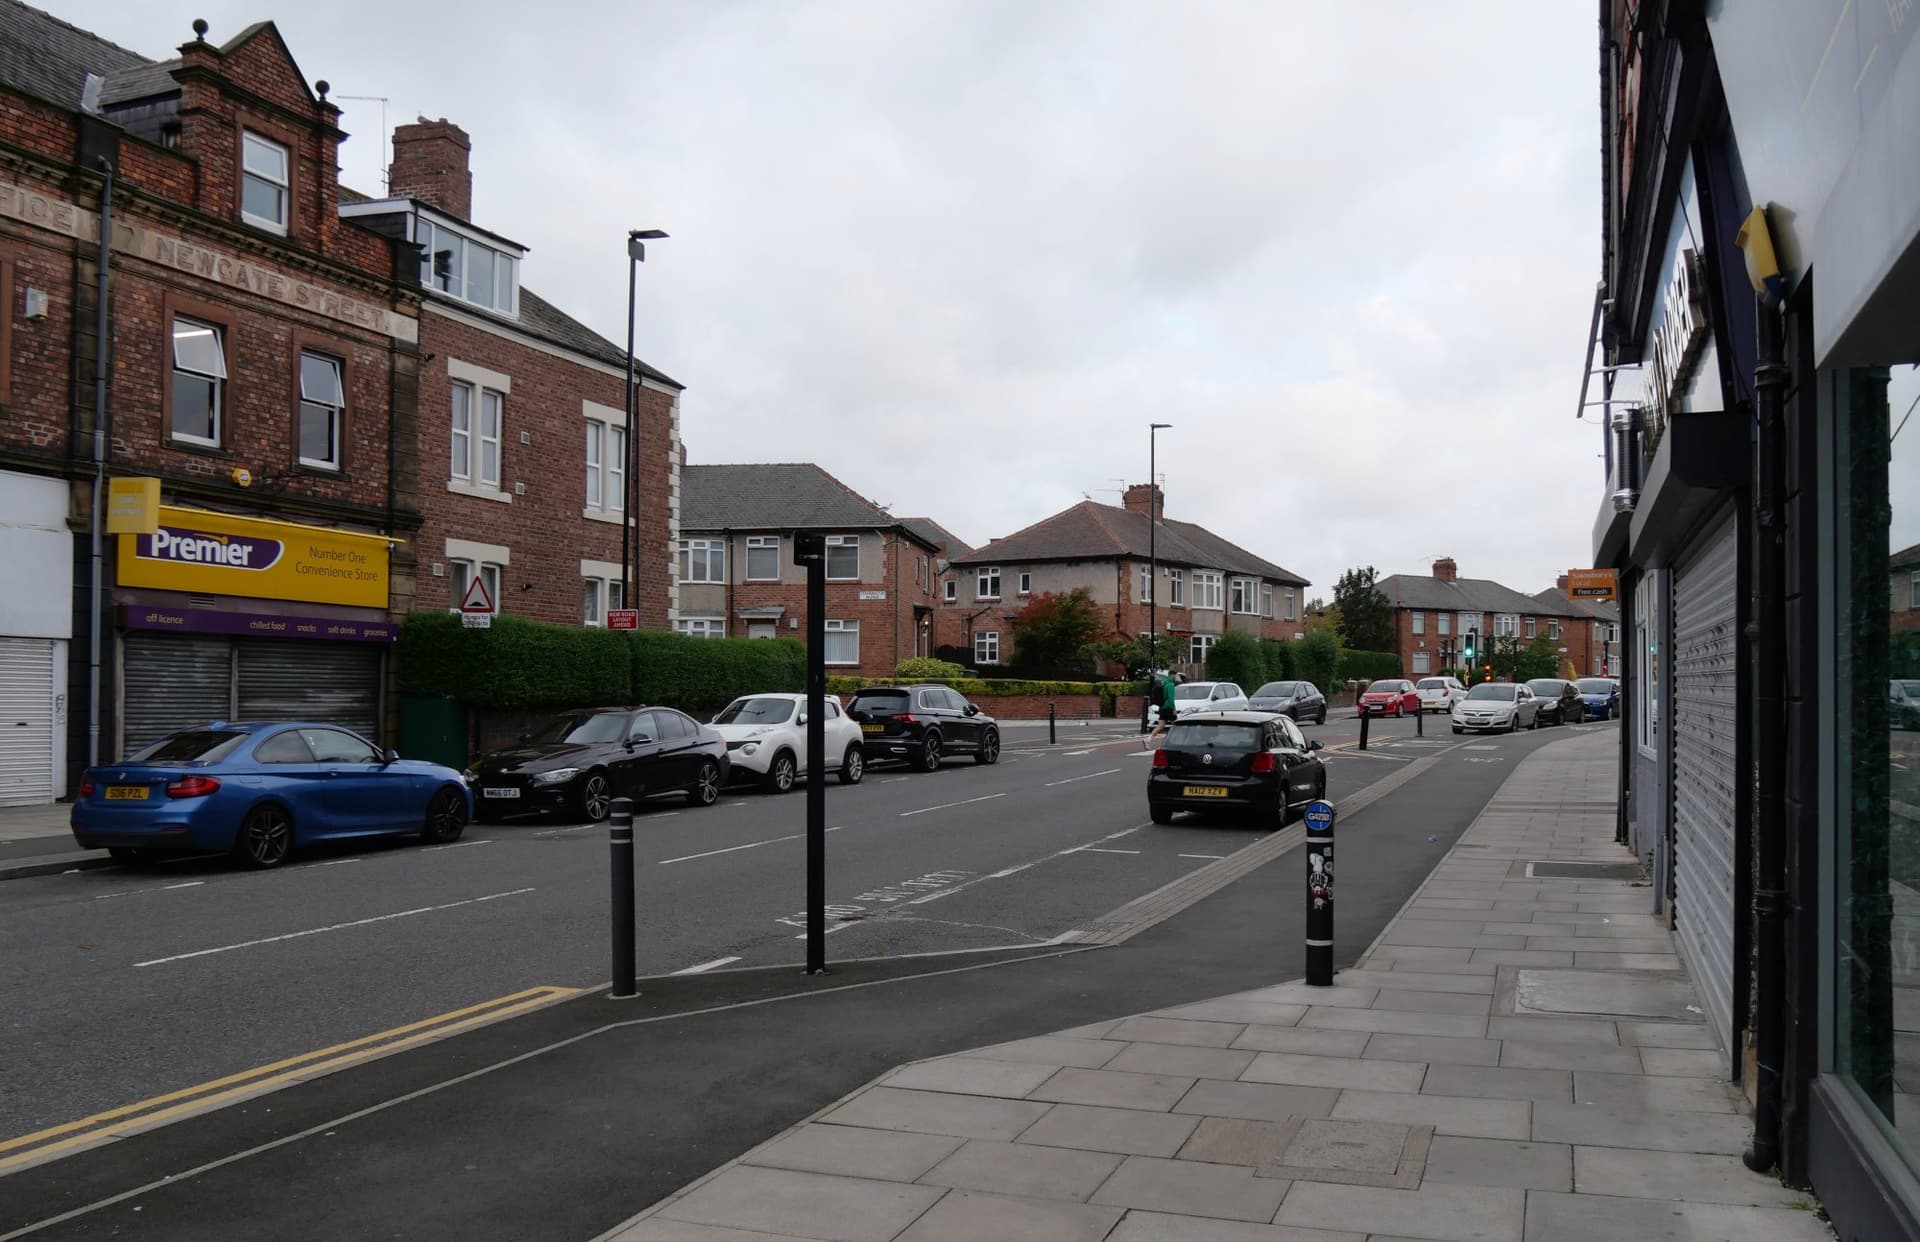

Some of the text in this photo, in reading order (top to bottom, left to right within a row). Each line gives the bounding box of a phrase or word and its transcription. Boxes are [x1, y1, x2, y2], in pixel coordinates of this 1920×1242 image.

[156, 236, 283, 298] NEWGATE
[151, 528, 253, 566] Premier
[309, 545, 367, 565] Number One
[295, 560, 378, 582] Convenience Store
[146, 613, 184, 624] off licence
[249, 620, 286, 631] chilled food
[296, 624, 317, 633] snacks
[327, 625, 339, 634] soft
